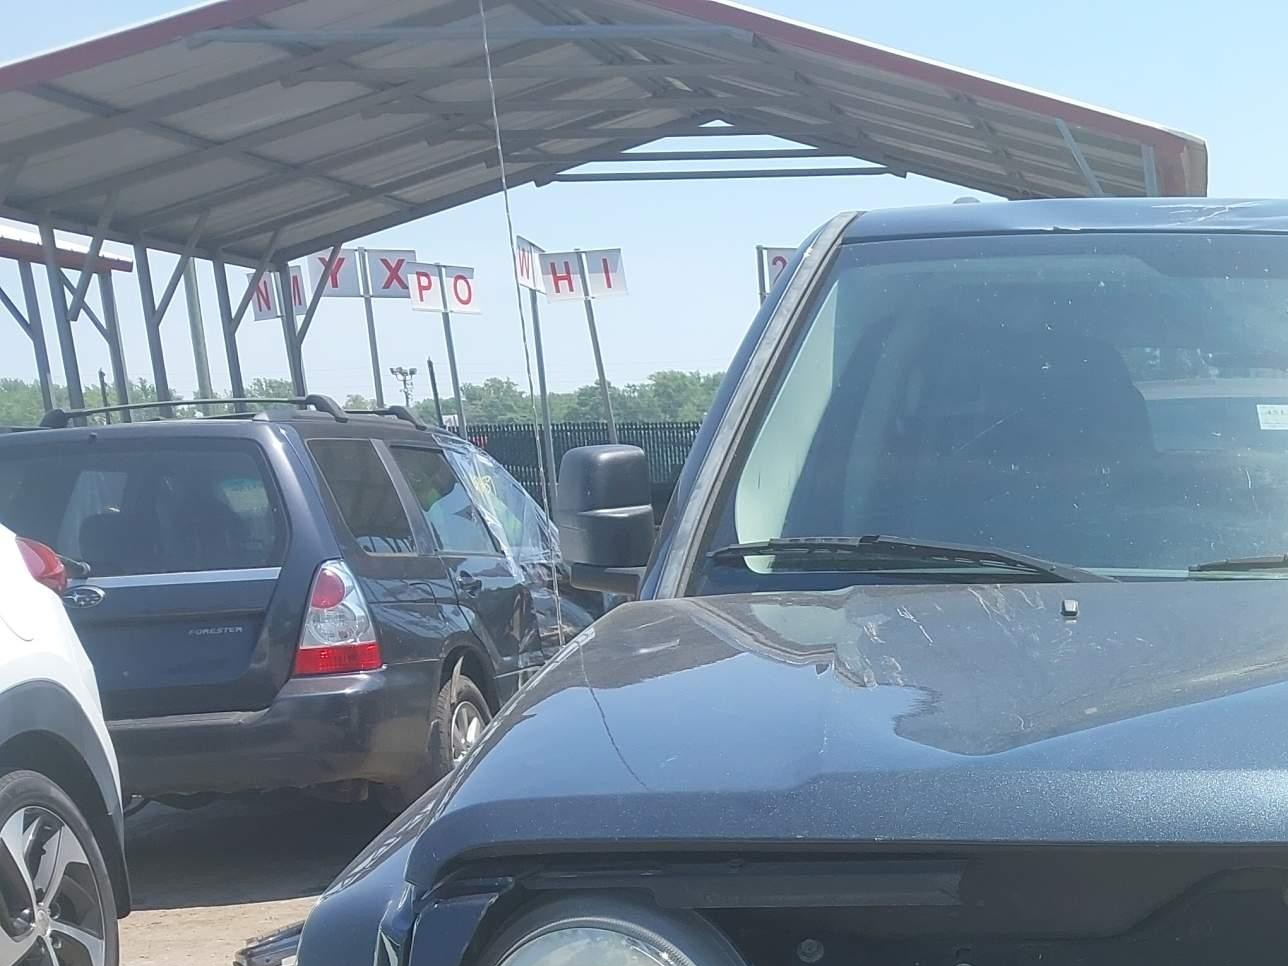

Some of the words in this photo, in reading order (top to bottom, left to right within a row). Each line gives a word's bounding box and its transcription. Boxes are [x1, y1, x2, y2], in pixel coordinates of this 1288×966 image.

[318, 256, 346, 289] Y
[380, 258, 409, 290] X
[416, 271, 433, 302] P
[550, 261, 575, 294] H
[254, 279, 272, 313] N
[453, 274, 472, 305] O
